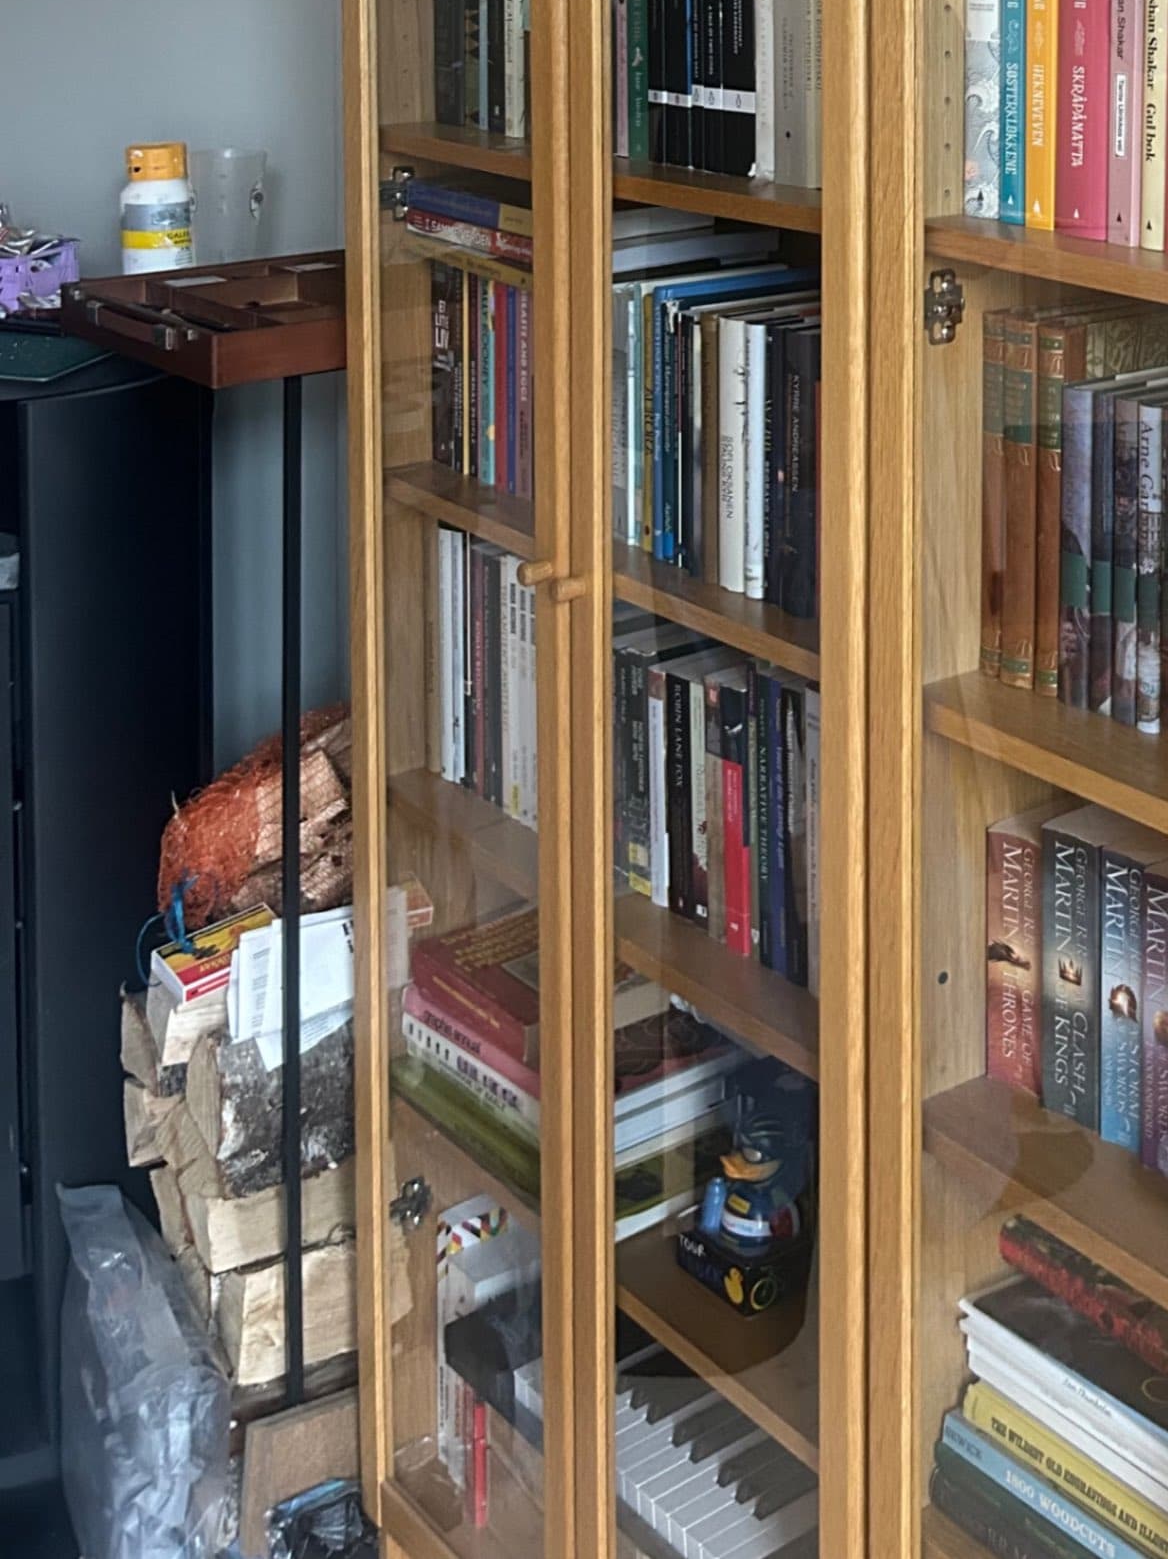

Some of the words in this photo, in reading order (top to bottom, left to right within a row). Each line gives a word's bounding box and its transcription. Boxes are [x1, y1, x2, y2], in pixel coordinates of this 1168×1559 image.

[1116, 17, 1127, 60] Shakar
[1146, 37, 1159, 89] Shakar
[1032, 64, 1045, 147] HEKNEVEVEN
[1071, 65, 1087, 167] SKRÅPÅNATTA
[1146, 103, 1157, 129] Gul
[1144, 132, 1157, 162] bok
[1140, 421, 1154, 469] Arne
[760, 745, 768, 823] NARRATIVE
[760, 829, 768, 883] THEORY
[1023, 848, 1034, 909] GEORGE
[1076, 847, 1088, 915] GEORGE
[1002, 842, 1022, 939] MARTIN
[1055, 842, 1075, 954] MARTIN
[1105, 861, 1128, 978] MARTIN
[1129, 868, 1142, 937] GEORGE
[1002, 972, 1020, 1058] THRONES
[1022, 989, 1033, 1035] GAME
[1022, 1043, 1033, 1064] OF
[1055, 1017, 1071, 1085] KINGS
[1073, 1011, 1087, 1092] CLASH
[1129, 1044, 1140, 1120] STORM
[991, 1417, 1007, 1437] THE
[1008, 1425, 1044, 1463] WILDEST
[1046, 1453, 1063, 1478] OLD
[1064, 1463, 1117, 1516] ENGRAVINGS
[1118, 1509, 1138, 1531] AND
[1039, 1494, 1116, 1558] WOODCUTS
